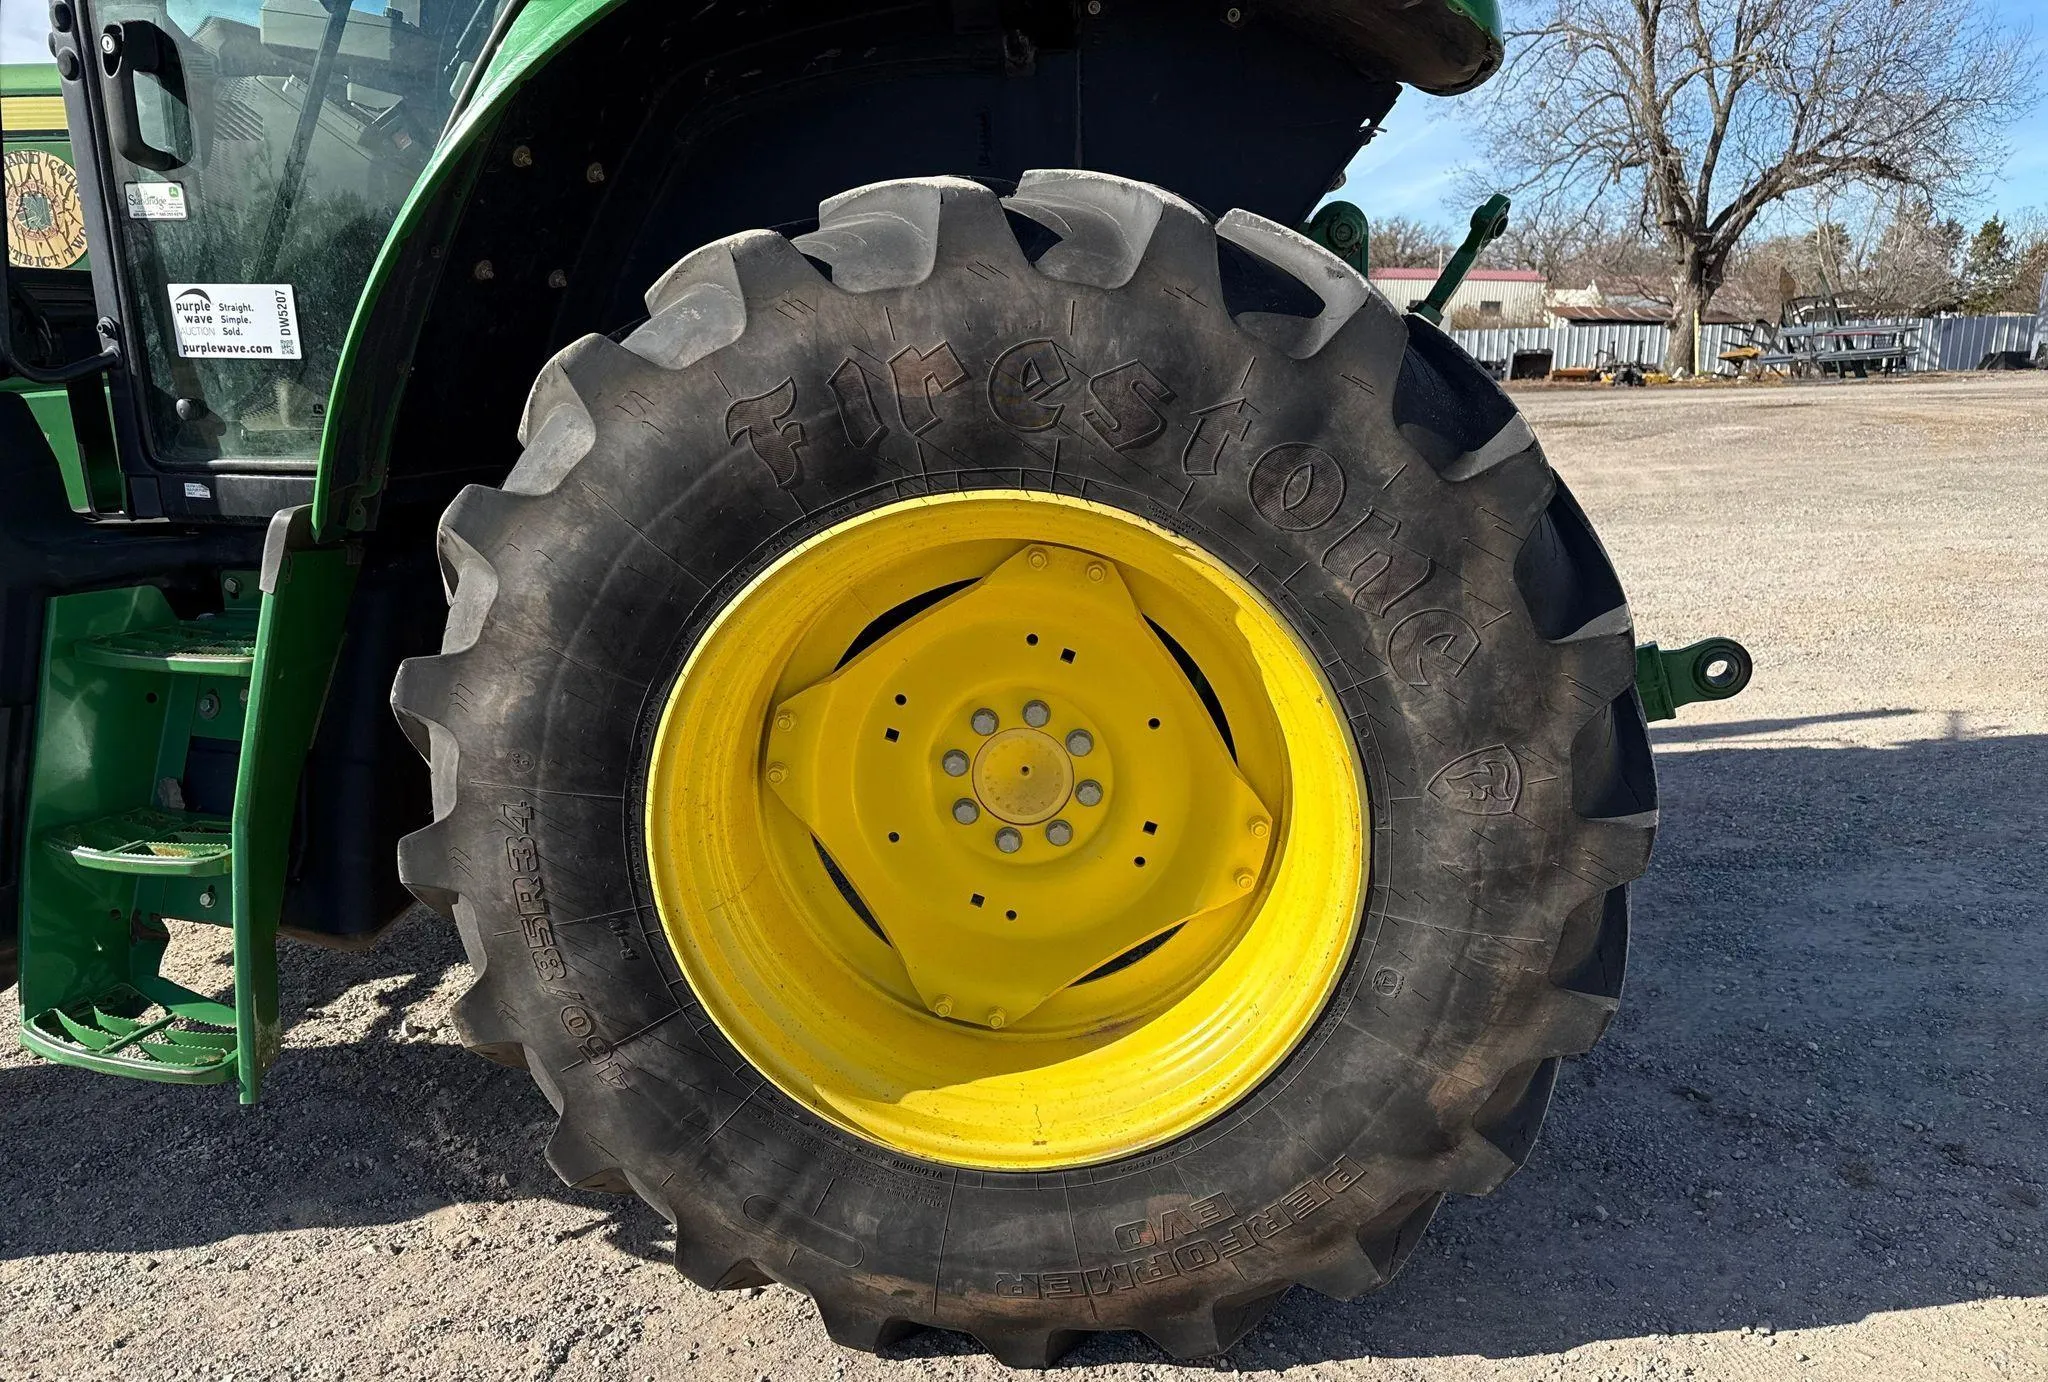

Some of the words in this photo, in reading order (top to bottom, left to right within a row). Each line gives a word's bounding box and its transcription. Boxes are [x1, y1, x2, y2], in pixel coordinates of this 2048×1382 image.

[175, 300, 211, 314] purple
[218, 302, 254, 314] Straight.
[275, 289, 291, 336] DW5207
[184, 315, 213, 324] wave
[220, 315, 252, 326] Simple.
[180, 326, 216, 336] AUCTION
[222, 327, 244, 336] Sold.
[183, 342, 273, 355] purplewave.com
[725, 337, 1482, 686] Firestone
[994, 1154, 1369, 1300] PERFORMER
[1113, 1190, 1238, 1253] EVO
